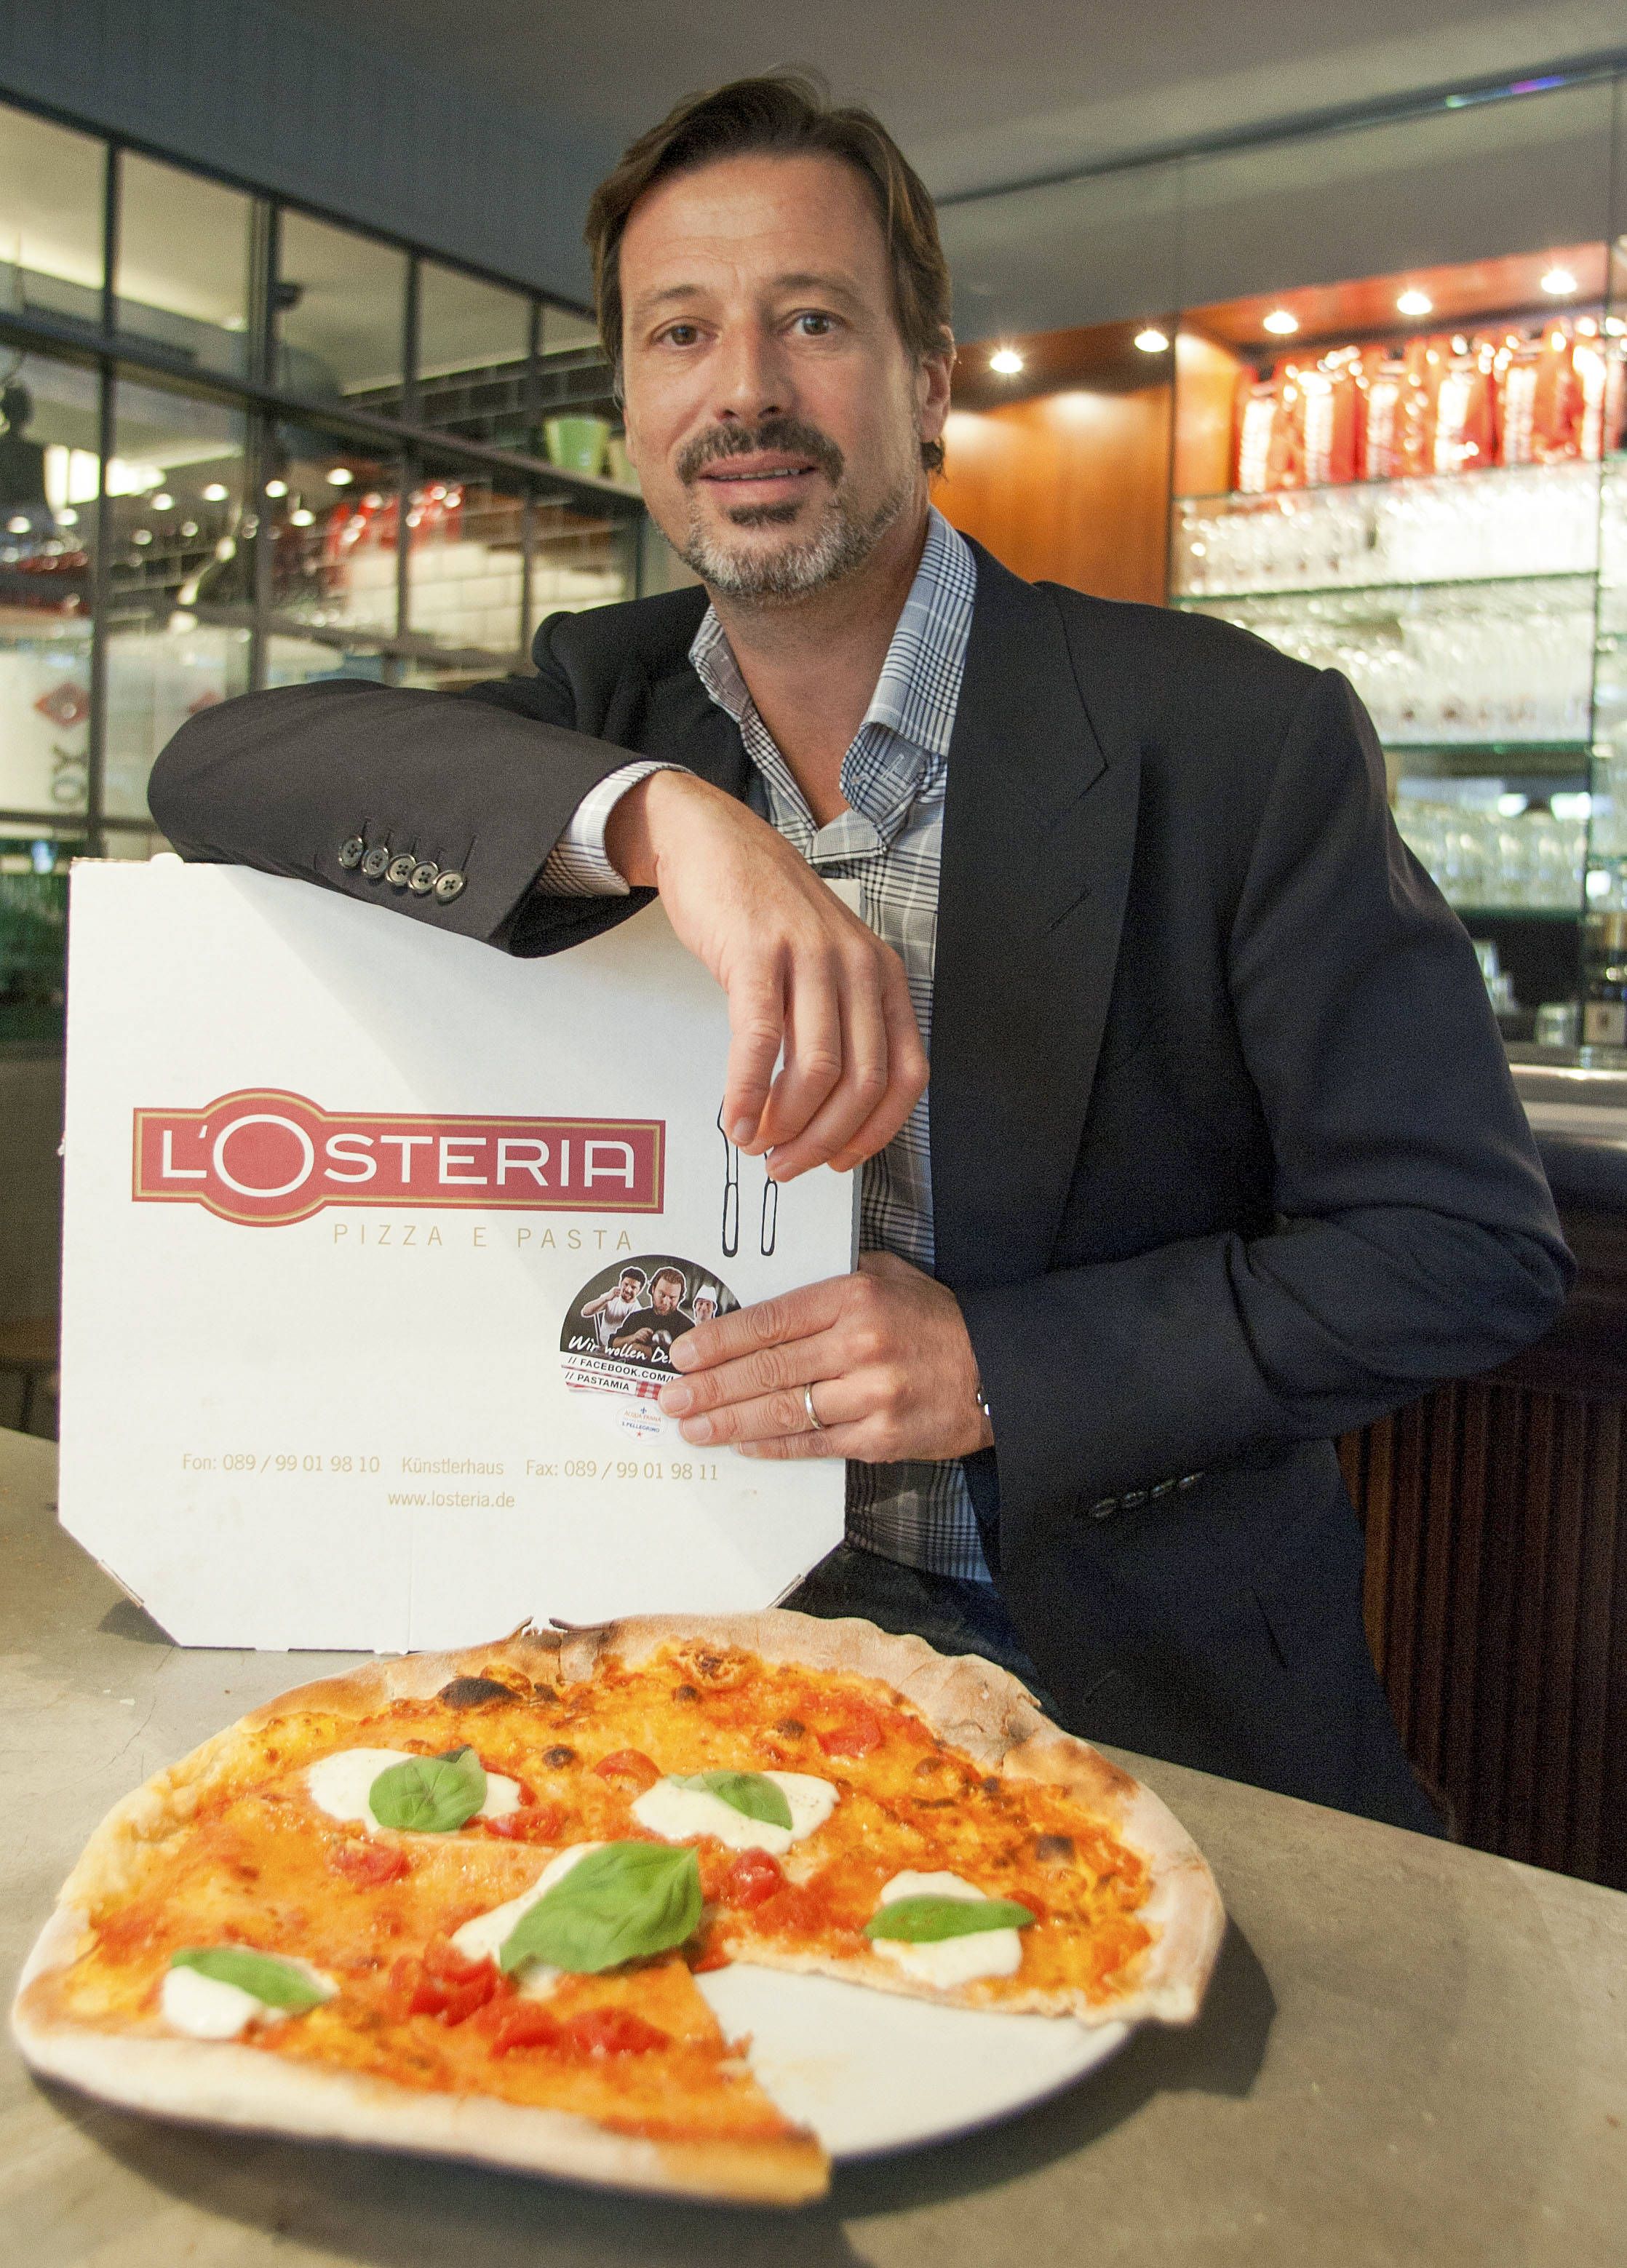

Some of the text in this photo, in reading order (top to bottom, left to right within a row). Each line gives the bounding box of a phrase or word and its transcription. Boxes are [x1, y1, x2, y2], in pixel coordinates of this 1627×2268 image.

[161, 1113, 636, 1198] L'OSTERIA
[333, 1223, 632, 1252] PIZZA E PASTA
[568, 1335, 600, 1352] Wir
[605, 1343, 647, 1361] wollen
[577, 1373, 630, 1391] PASTAMIA
[183, 1454, 217, 1471] Fon:
[402, 1456, 504, 1476] Künstlerhaus
[526, 1459, 558, 1477] Fax:
[388, 1490, 515, 1508] www.losteria.de
